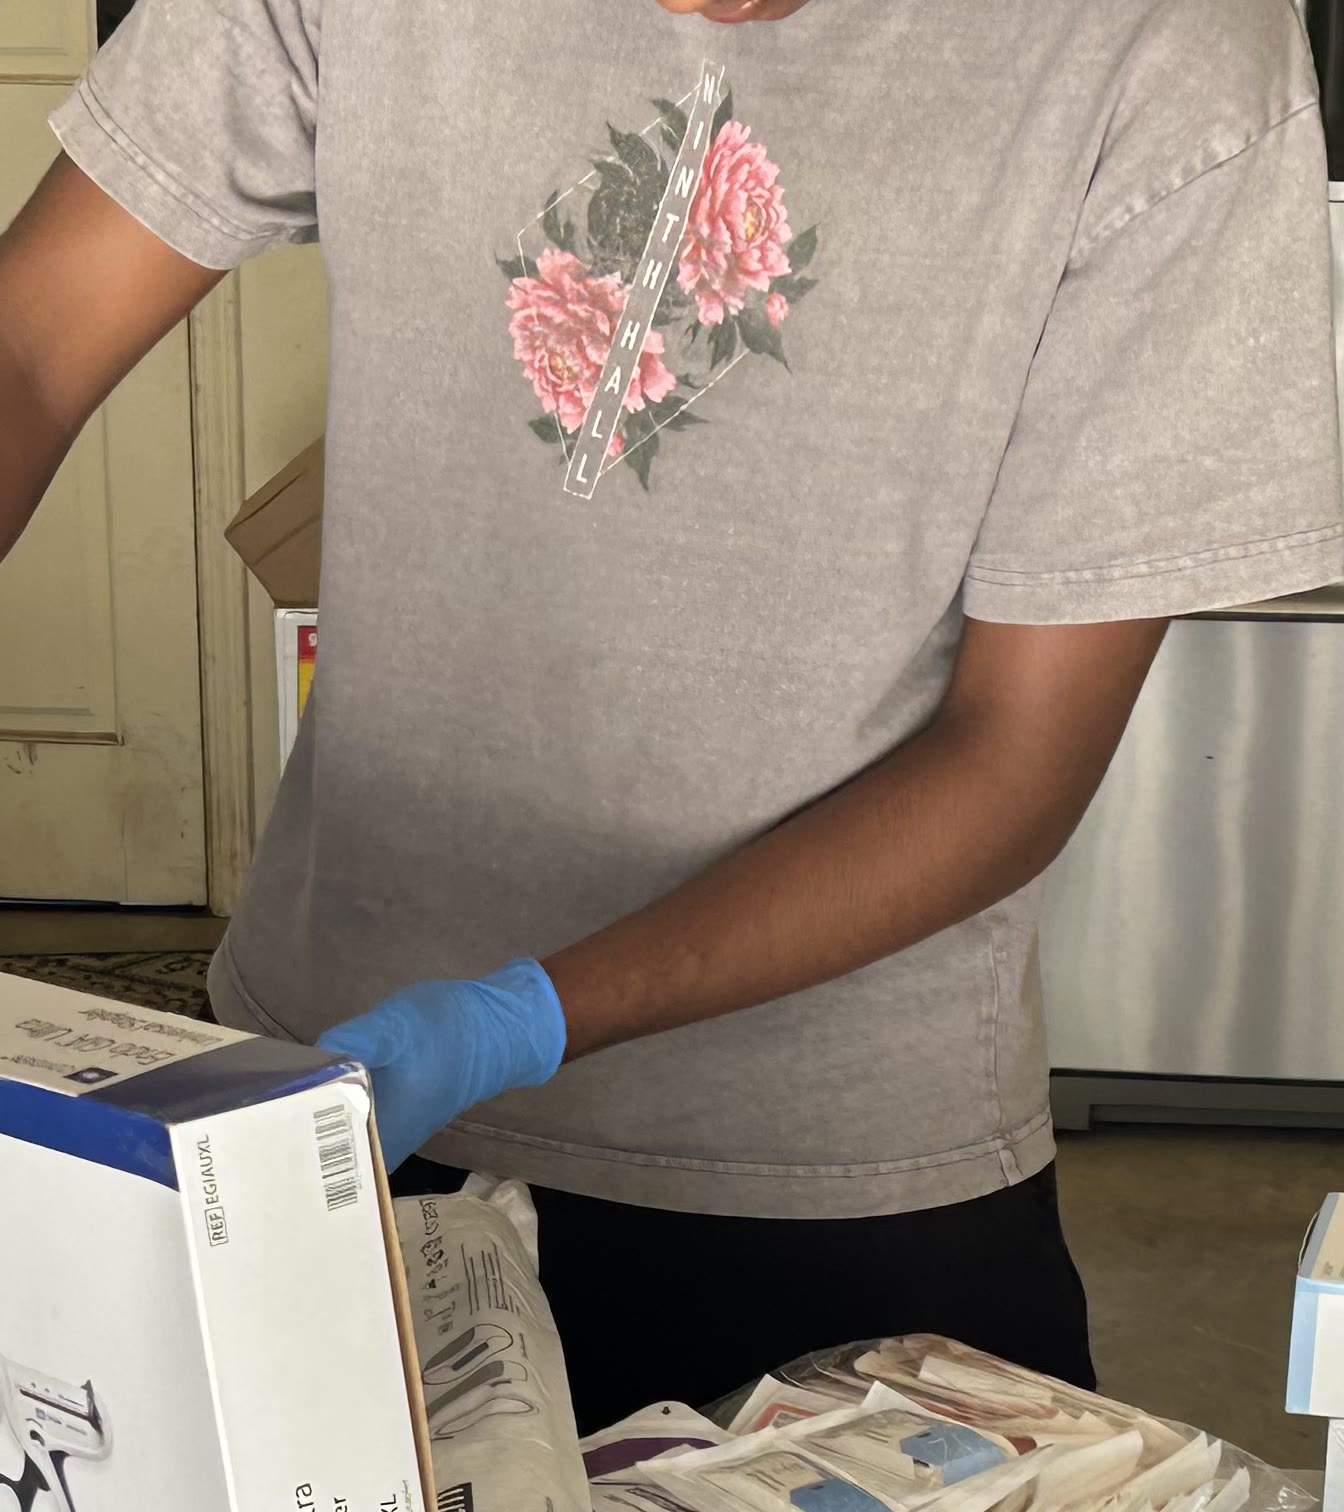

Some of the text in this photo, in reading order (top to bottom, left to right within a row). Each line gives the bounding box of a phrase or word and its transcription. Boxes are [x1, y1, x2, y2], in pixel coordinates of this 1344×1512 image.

[576, 321, 641, 483] HALL
[197, 1134, 226, 1241] REF EGIAUXL
